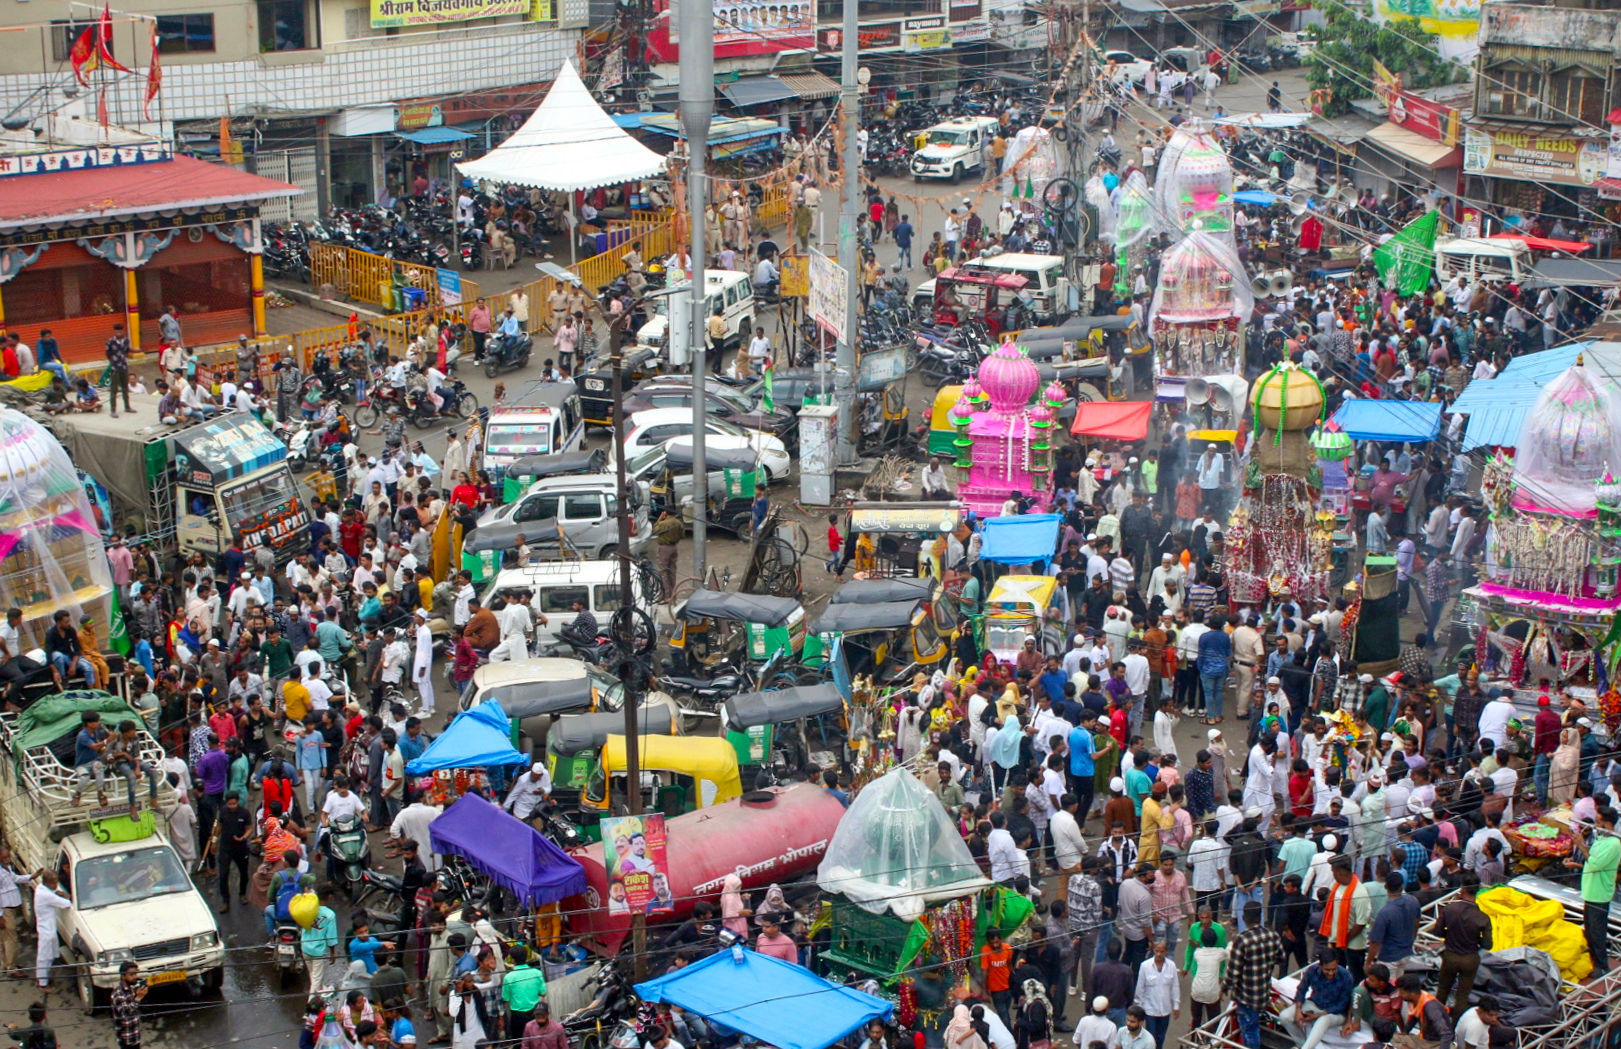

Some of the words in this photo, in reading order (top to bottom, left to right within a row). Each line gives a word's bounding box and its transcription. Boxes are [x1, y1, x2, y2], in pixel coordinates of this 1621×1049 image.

[1496, 131, 1530, 148] DAILY
[1535, 136, 1577, 154] NEEDS
[779, 839, 828, 864] भोपाल
